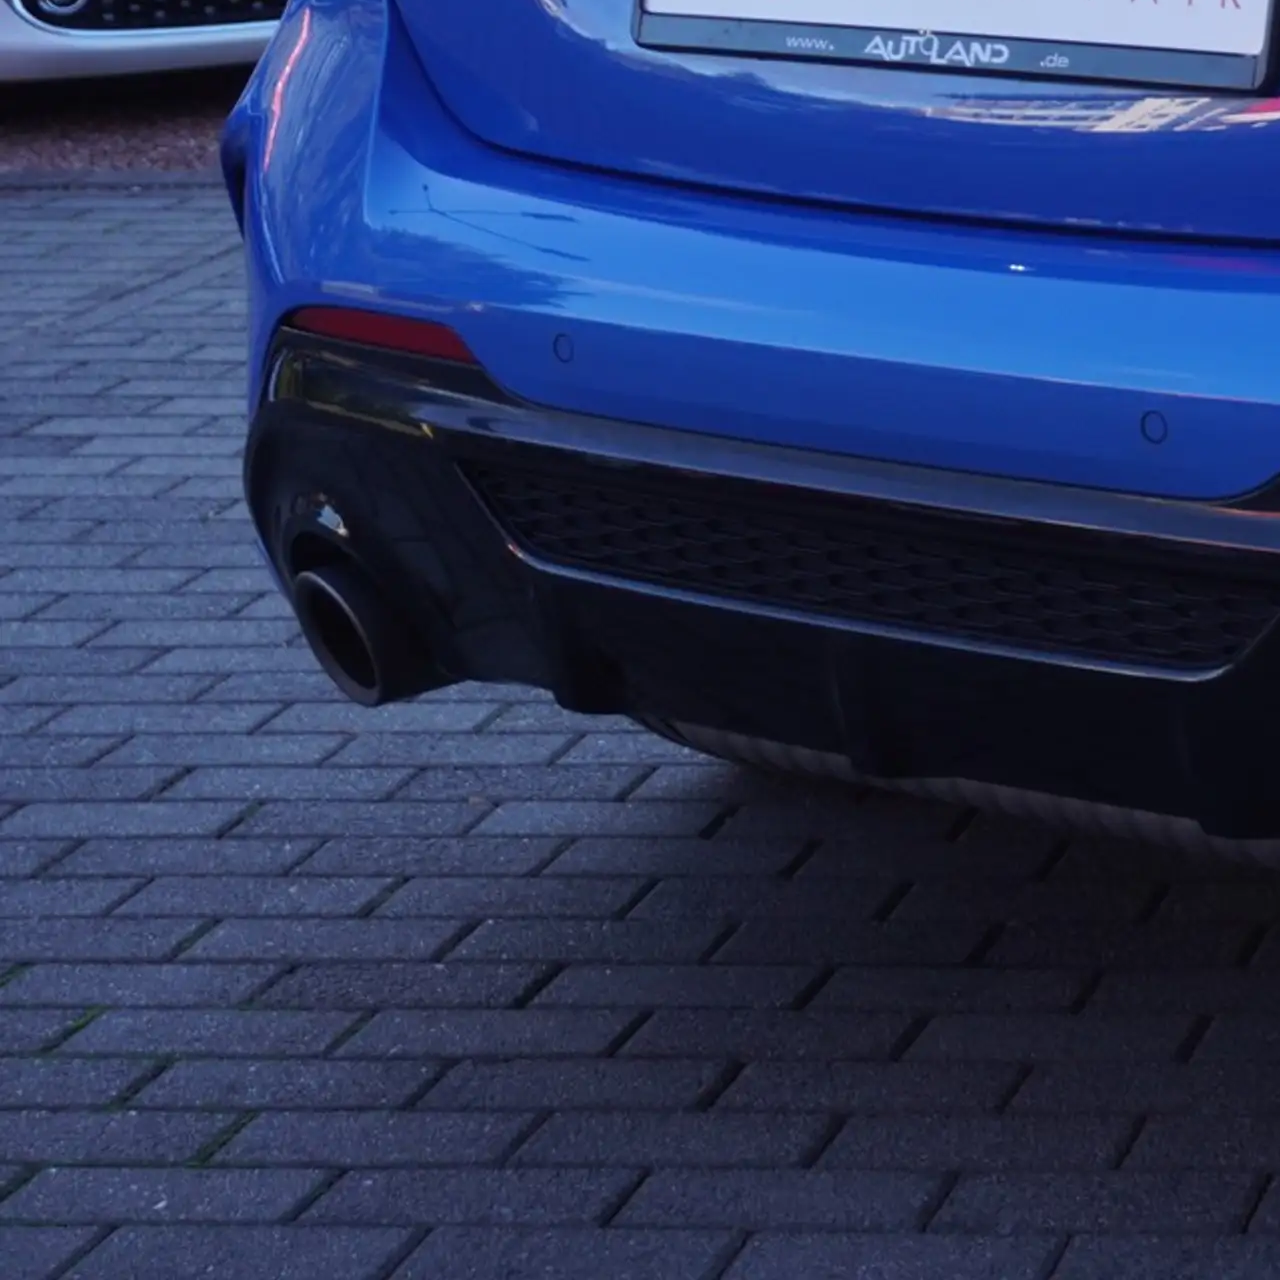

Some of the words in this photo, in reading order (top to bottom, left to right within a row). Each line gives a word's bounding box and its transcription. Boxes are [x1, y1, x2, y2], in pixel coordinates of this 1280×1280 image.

[785, 35, 835, 51] www.
[864, 32, 1011, 67] AUTOLAND
[1040, 53, 1070, 68] .de
